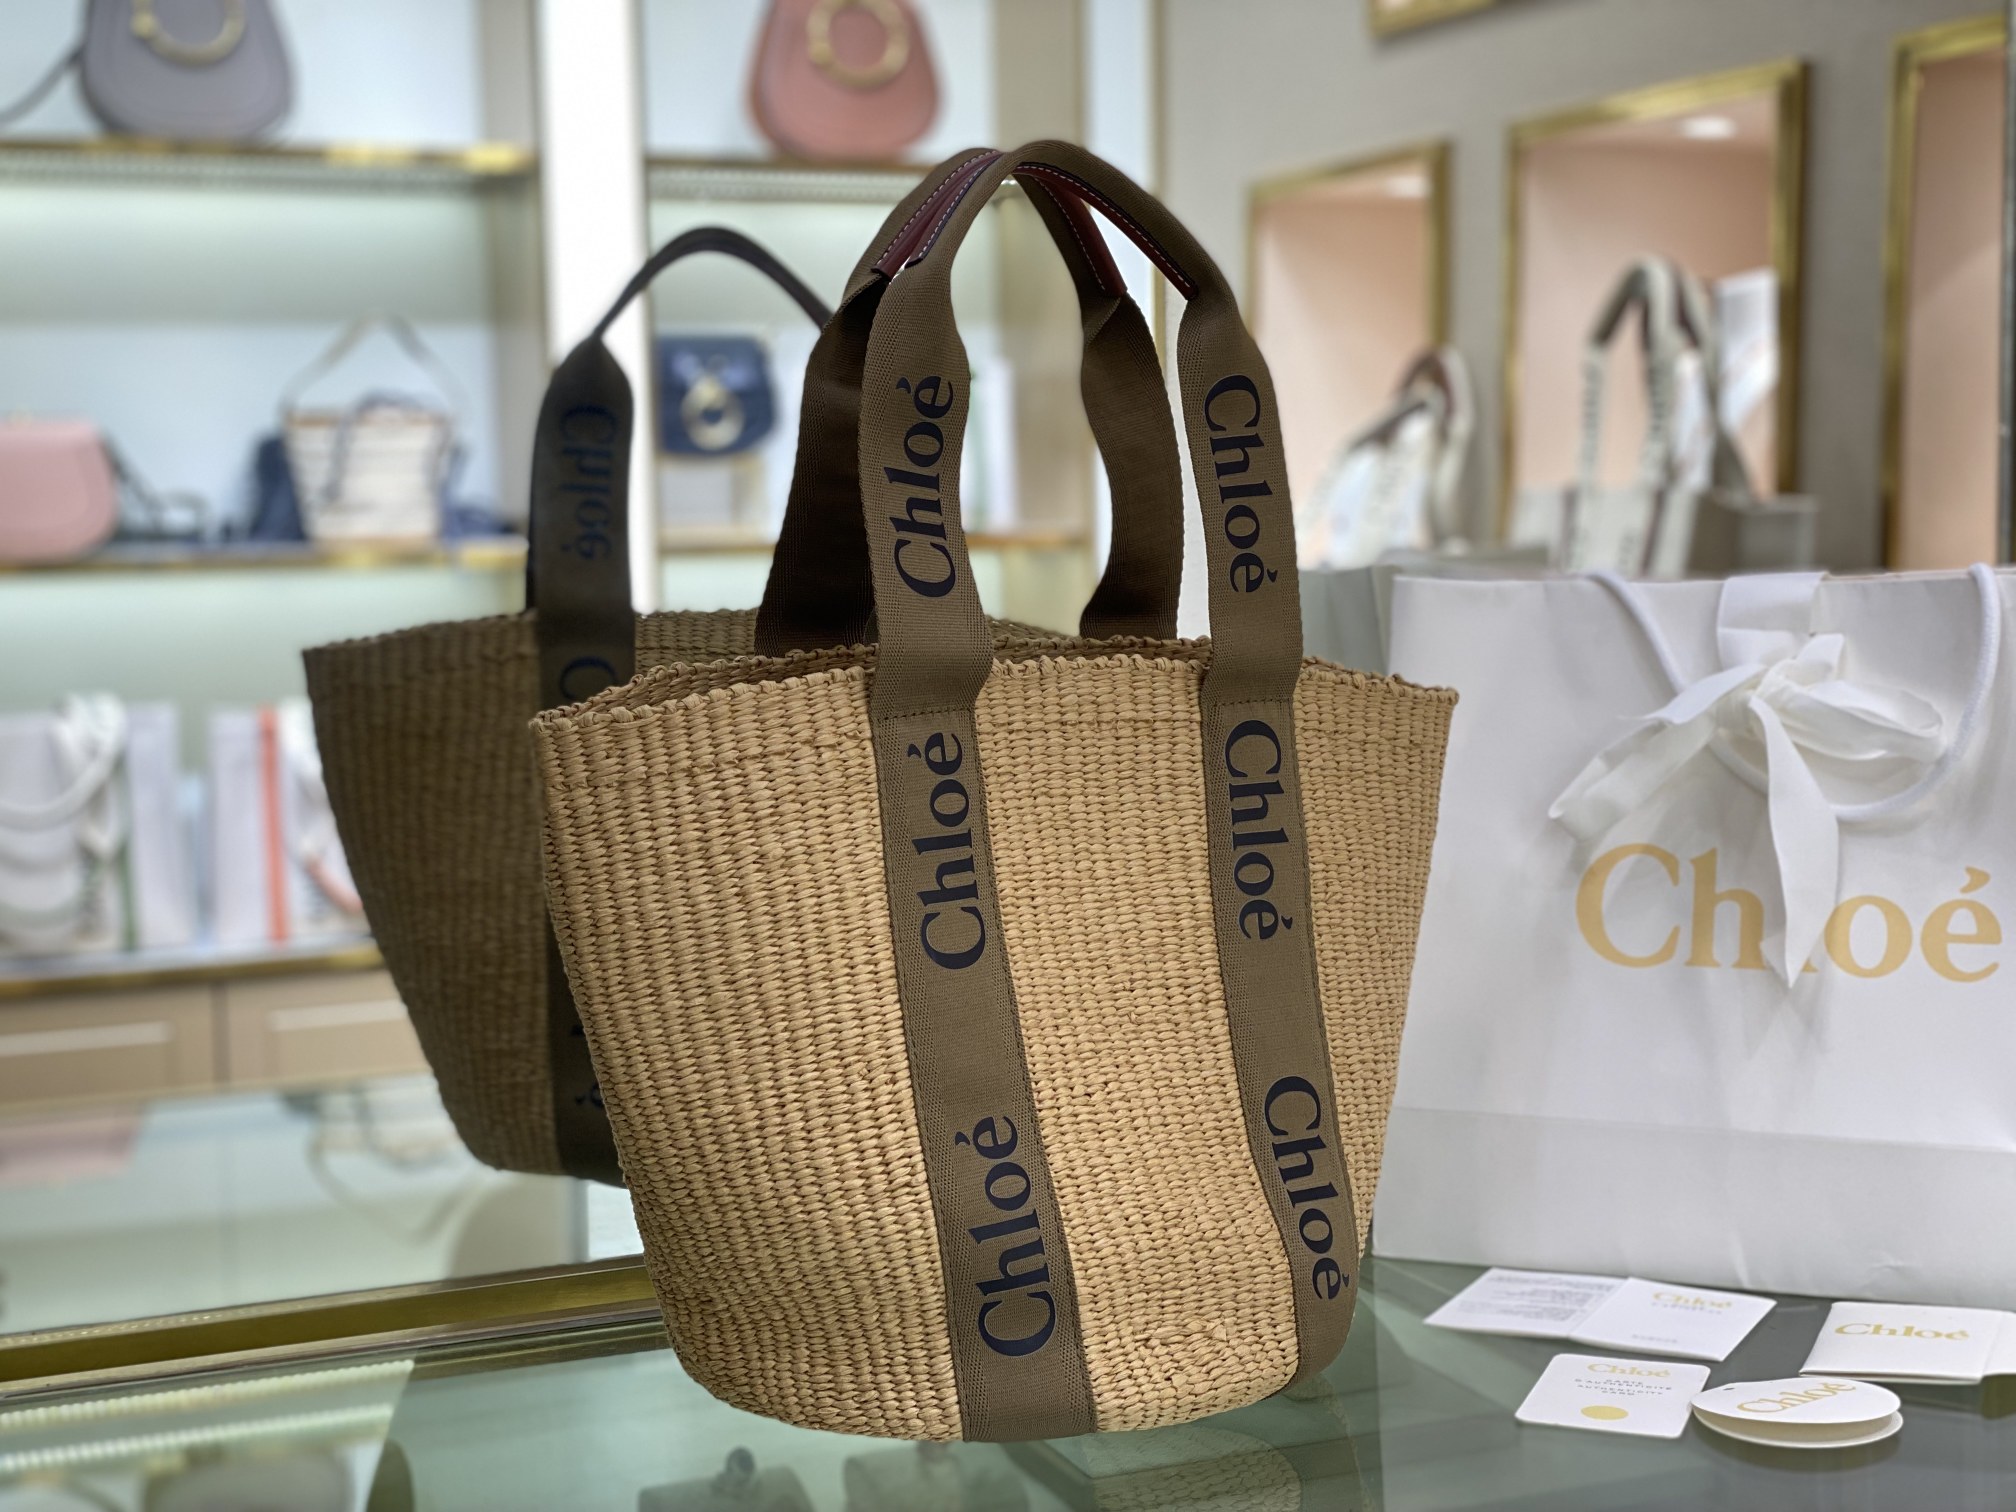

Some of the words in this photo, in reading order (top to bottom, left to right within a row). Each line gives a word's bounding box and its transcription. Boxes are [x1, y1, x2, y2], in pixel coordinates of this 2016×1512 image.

[883, 374, 957, 599] Chloé
[1204, 374, 1279, 593] Chloé
[907, 732, 986, 970] Chloé
[1225, 719, 1294, 940] Chloé
[1575, 842, 2003, 983] Choé
[954, 1115, 1056, 1358] Chloé
[1264, 1075, 1351, 1300] Chloé
[1737, 1381, 1857, 1413] Chloé
[1834, 1323, 1970, 1340] Chloé
